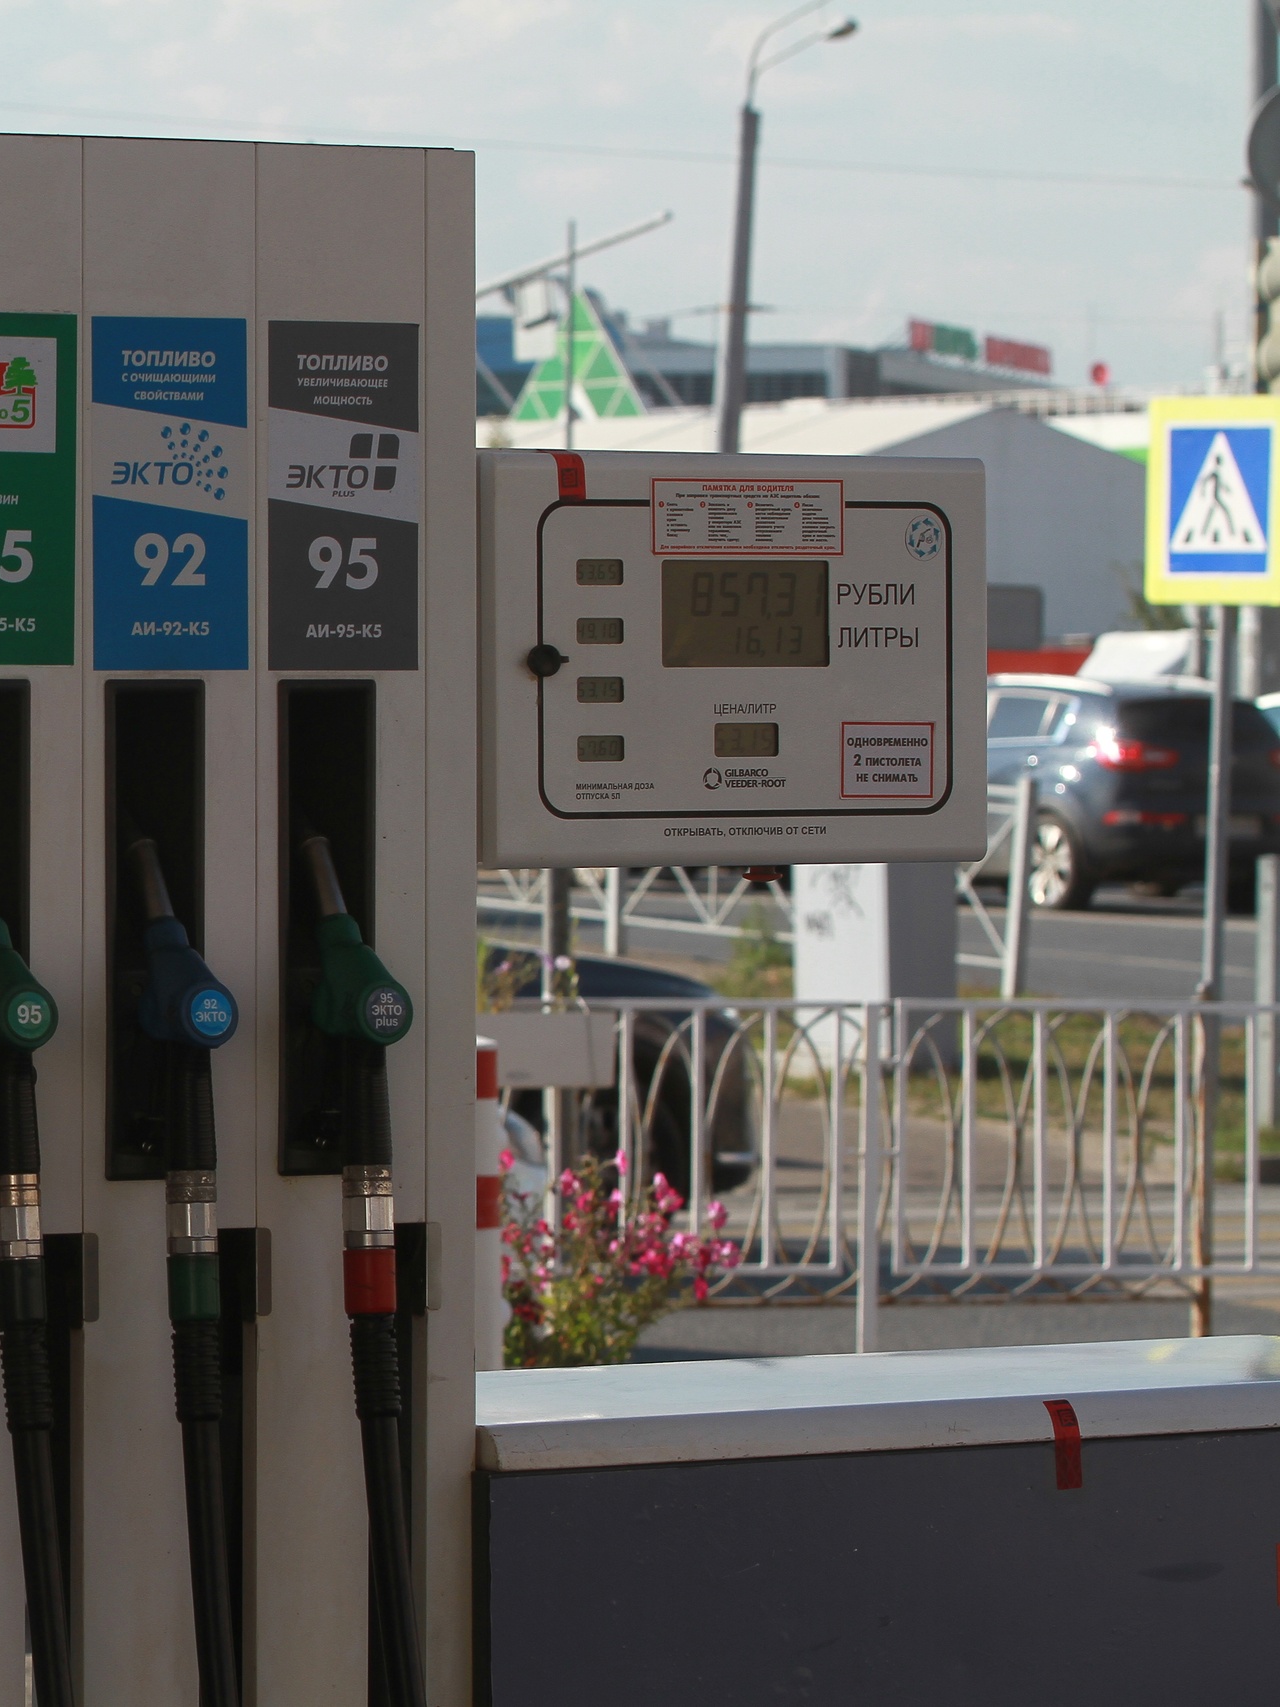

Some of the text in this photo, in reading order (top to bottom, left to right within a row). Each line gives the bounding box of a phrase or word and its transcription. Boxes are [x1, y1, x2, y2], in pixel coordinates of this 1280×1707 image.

[122, 350, 216, 367] ТОПЛИВО
[297, 354, 389, 372] ТОПЛИВО
[122, 373, 216, 384] С ОЧИЩАЮЩИМИ
[297, 378, 388, 389] УВЕЛИЧИВАЮЩЕЕ
[134, 390, 204, 402] СВОЙСТВАМИ
[313, 395, 373, 406] МОЩНОСТЬ
[10, 399, 30, 422] 5
[111, 462, 193, 485] ЭКТО
[286, 465, 369, 489] ЭКТО
[134, 532, 206, 586] 92
[308, 536, 378, 590] 95
[836, 584, 915, 605] РУБЛИ
[132, 622, 210, 636] АИ-92-К5
[306, 624, 382, 638] АИ-95-К5
[736, 626, 802, 658] 16,13
[838, 627, 918, 648] ЛИТРЫ
[714, 704, 777, 716] ЦЕНА/ЛИТР
[847, 737, 928, 748] ОДНОВРЕМЕННО
[853, 754, 922, 767] 2 ПИСТОЛЕТА
[724, 769, 768, 777] GILBARCO
[856, 773, 918, 783] НЕ СНИМАТЬ
[634, 782, 654, 791] ДОЗА
[724, 779, 786, 788] VEEDER-ROOT
[664, 826, 827, 838] ОТКРЫВАТЬ, ОТКЛЮЧИВ ОТ СЕТИ
[204, 998, 218, 1009] 92
[380, 993, 394, 1003] 95
[17, 1004, 43, 1024] 95
[372, 1004, 403, 1016] ЭКТО
[195, 1011, 228, 1024] ЭКТО
[375, 1016, 399, 1028] plus
